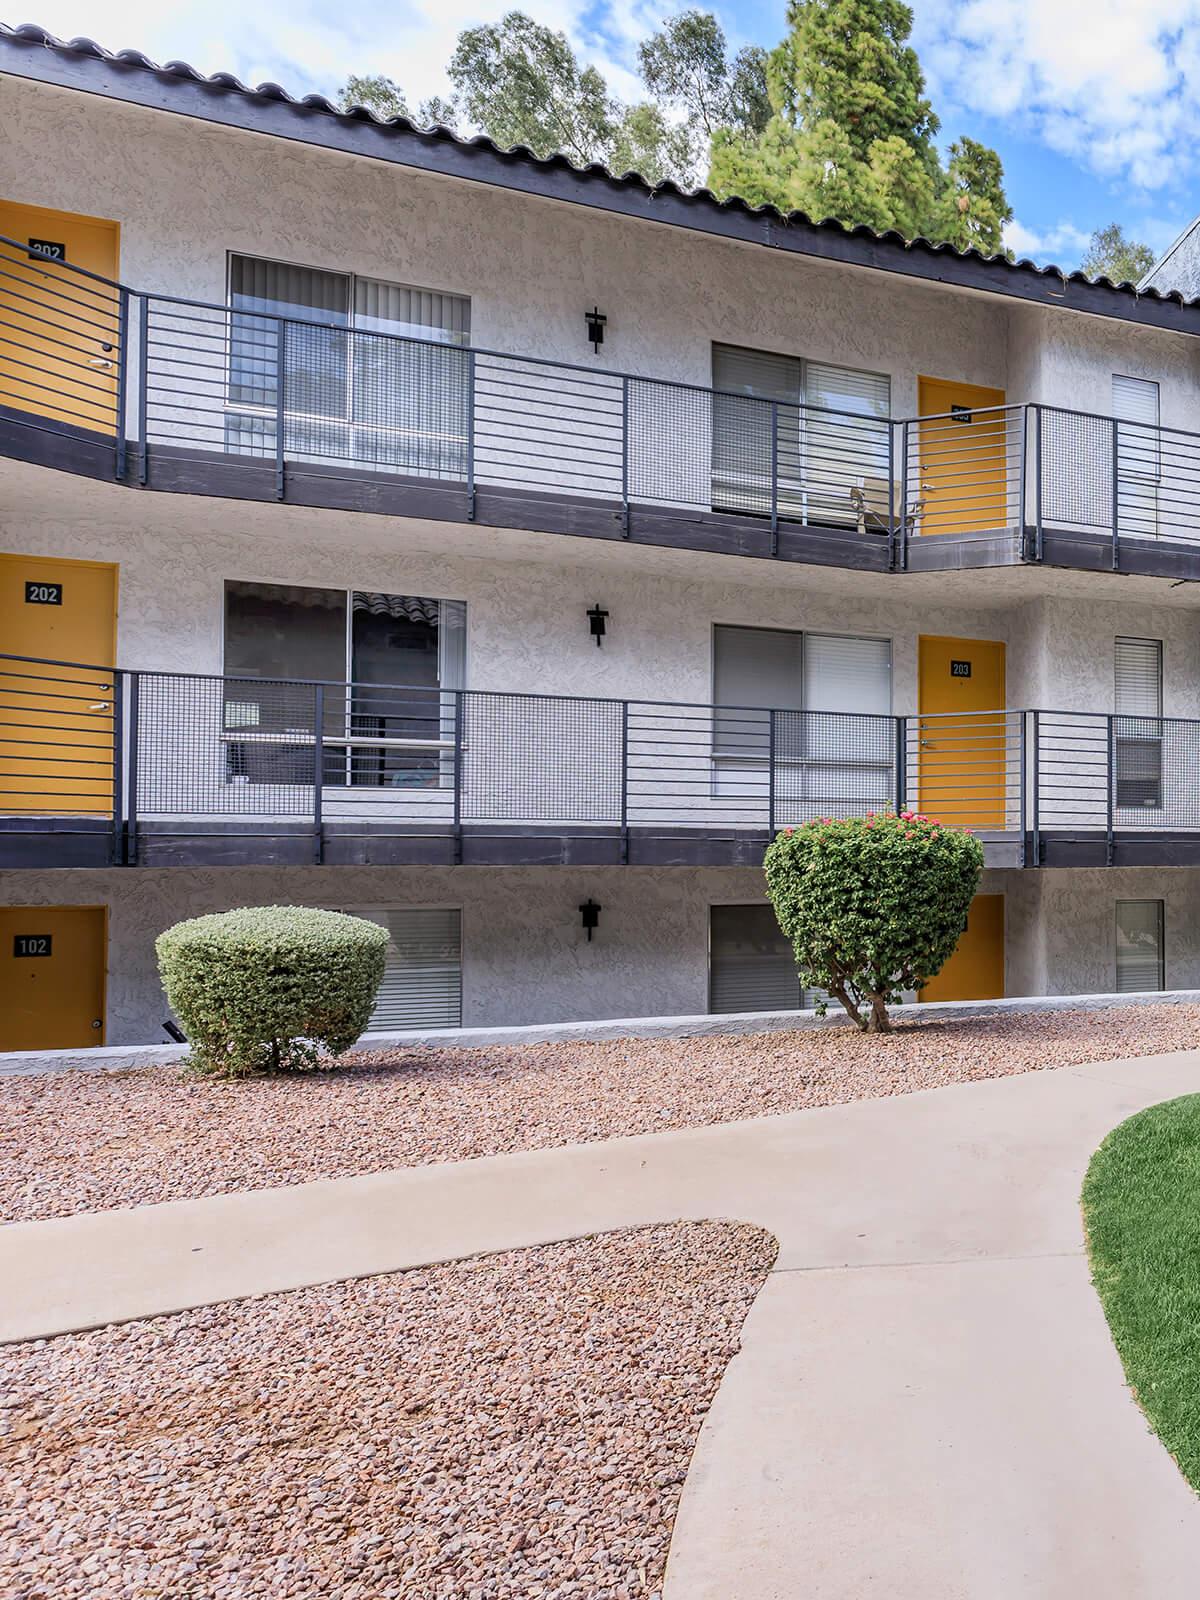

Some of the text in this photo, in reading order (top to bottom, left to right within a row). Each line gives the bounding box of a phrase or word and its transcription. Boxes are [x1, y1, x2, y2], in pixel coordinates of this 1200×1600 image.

[30, 586, 57, 602] 202
[953, 663, 969, 675] 203
[20, 939, 47, 953] 102
